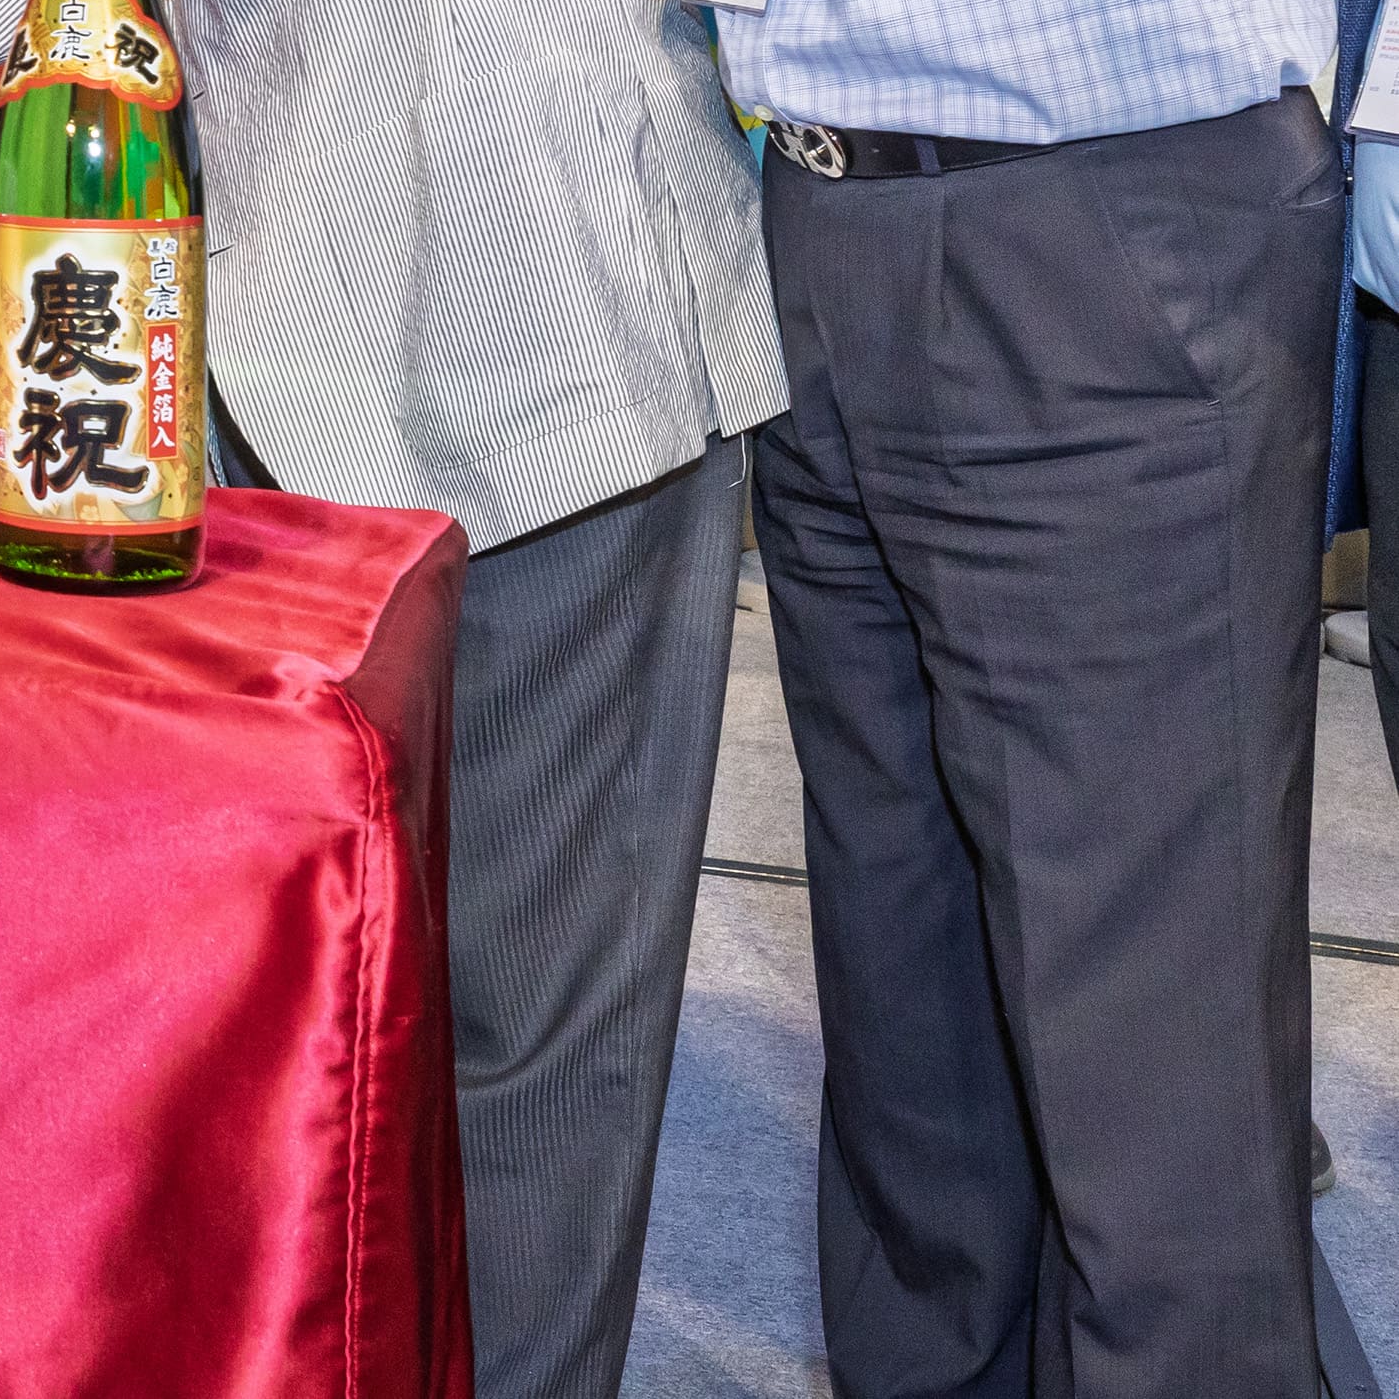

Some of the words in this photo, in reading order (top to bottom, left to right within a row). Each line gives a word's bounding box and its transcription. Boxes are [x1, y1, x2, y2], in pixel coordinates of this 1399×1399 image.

[13, 252, 150, 500] 慶祝
[150, 332, 176, 449] 純金箔入
